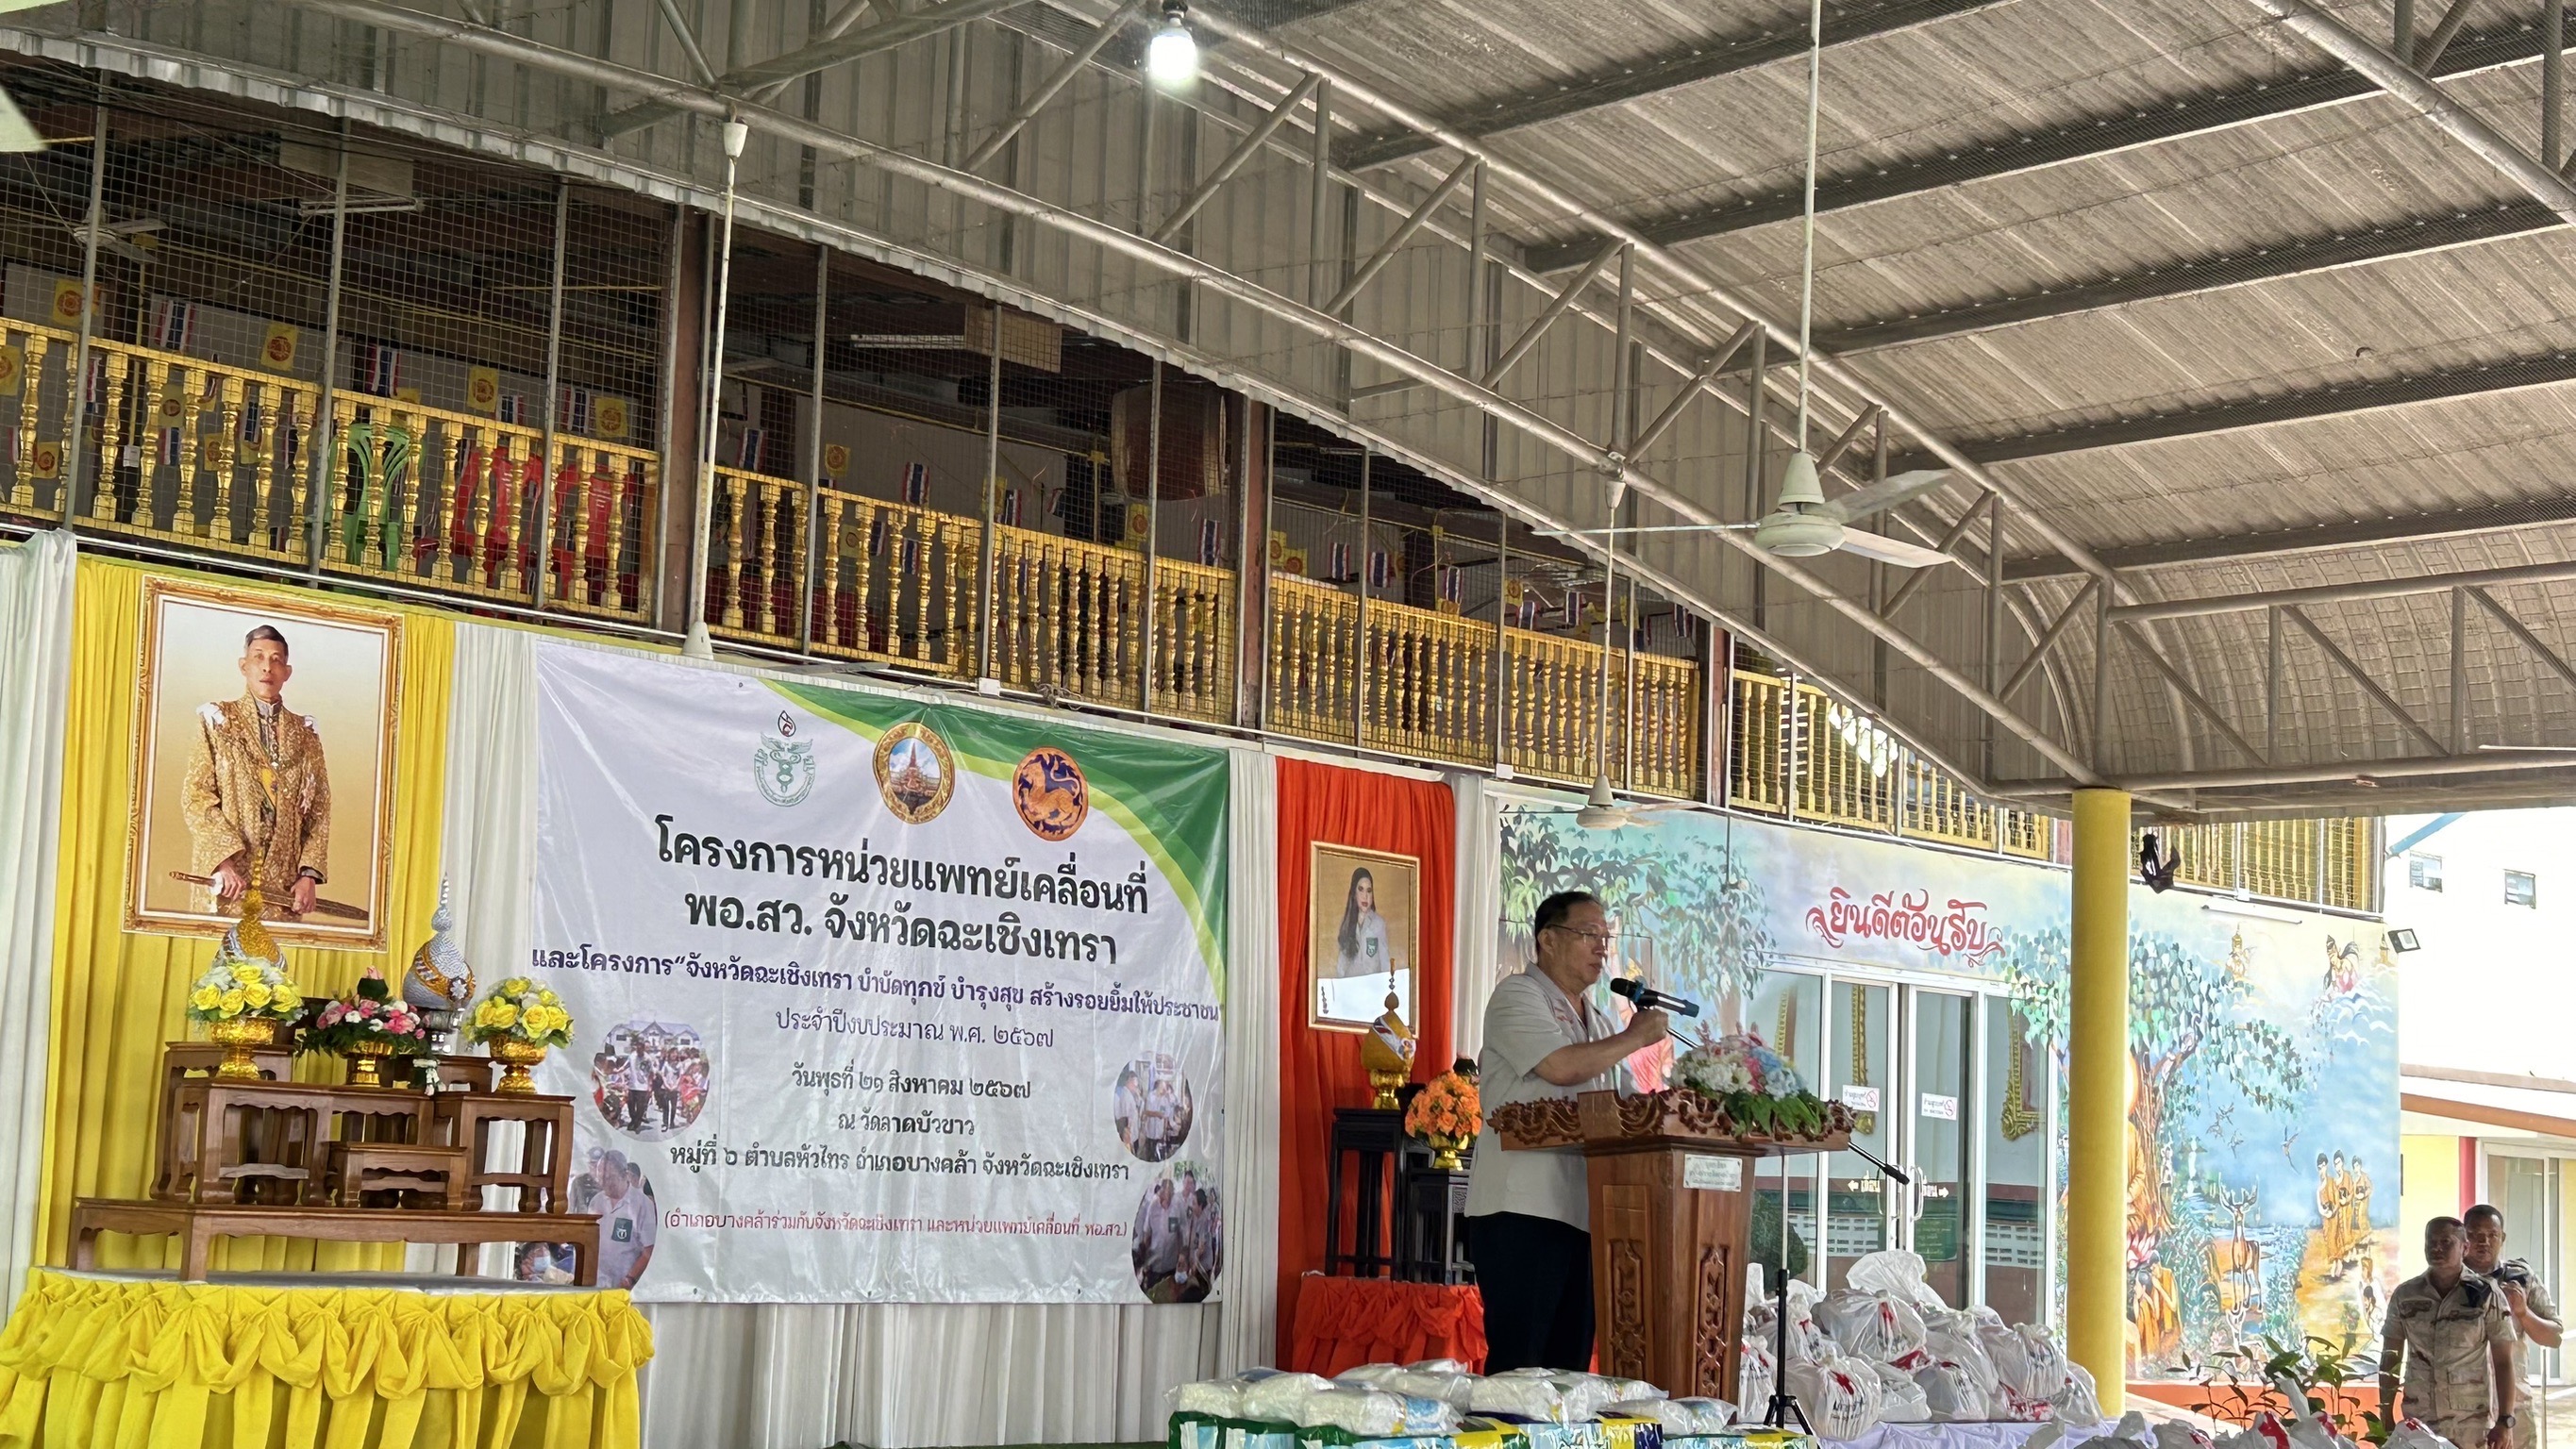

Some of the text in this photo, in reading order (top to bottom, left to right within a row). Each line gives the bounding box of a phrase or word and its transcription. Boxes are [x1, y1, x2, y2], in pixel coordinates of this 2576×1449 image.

[655, 813, 1148, 914] โครงการหน่วยแพทย์เคลื่อนที่
[684, 891, 1117, 965] พอ.สว. จังหวัดฉะเชิงเทรา
[1827, 885, 1990, 957] ยินดีต้อนรับ
[857, 967, 946, 1006] บำบัดทุกข์
[950, 975, 1025, 1011] บำรุงสุข
[775, 1006, 1054, 1048] ประจำปีงบประมาณ พ.ศ. ๒๕๖๗
[791, 1058, 855, 1097] วันพุธที่
[887, 1068, 964, 1096] สิงหาคม
[968, 1077, 1031, 1099] ๒๕๖๗
[837, 1106, 976, 1136] ณ วัดลาดบัวขาว
[670, 1133, 718, 1174] หมู่ที่
[855, 1146, 978, 1175] อำเภอบางคล้า
